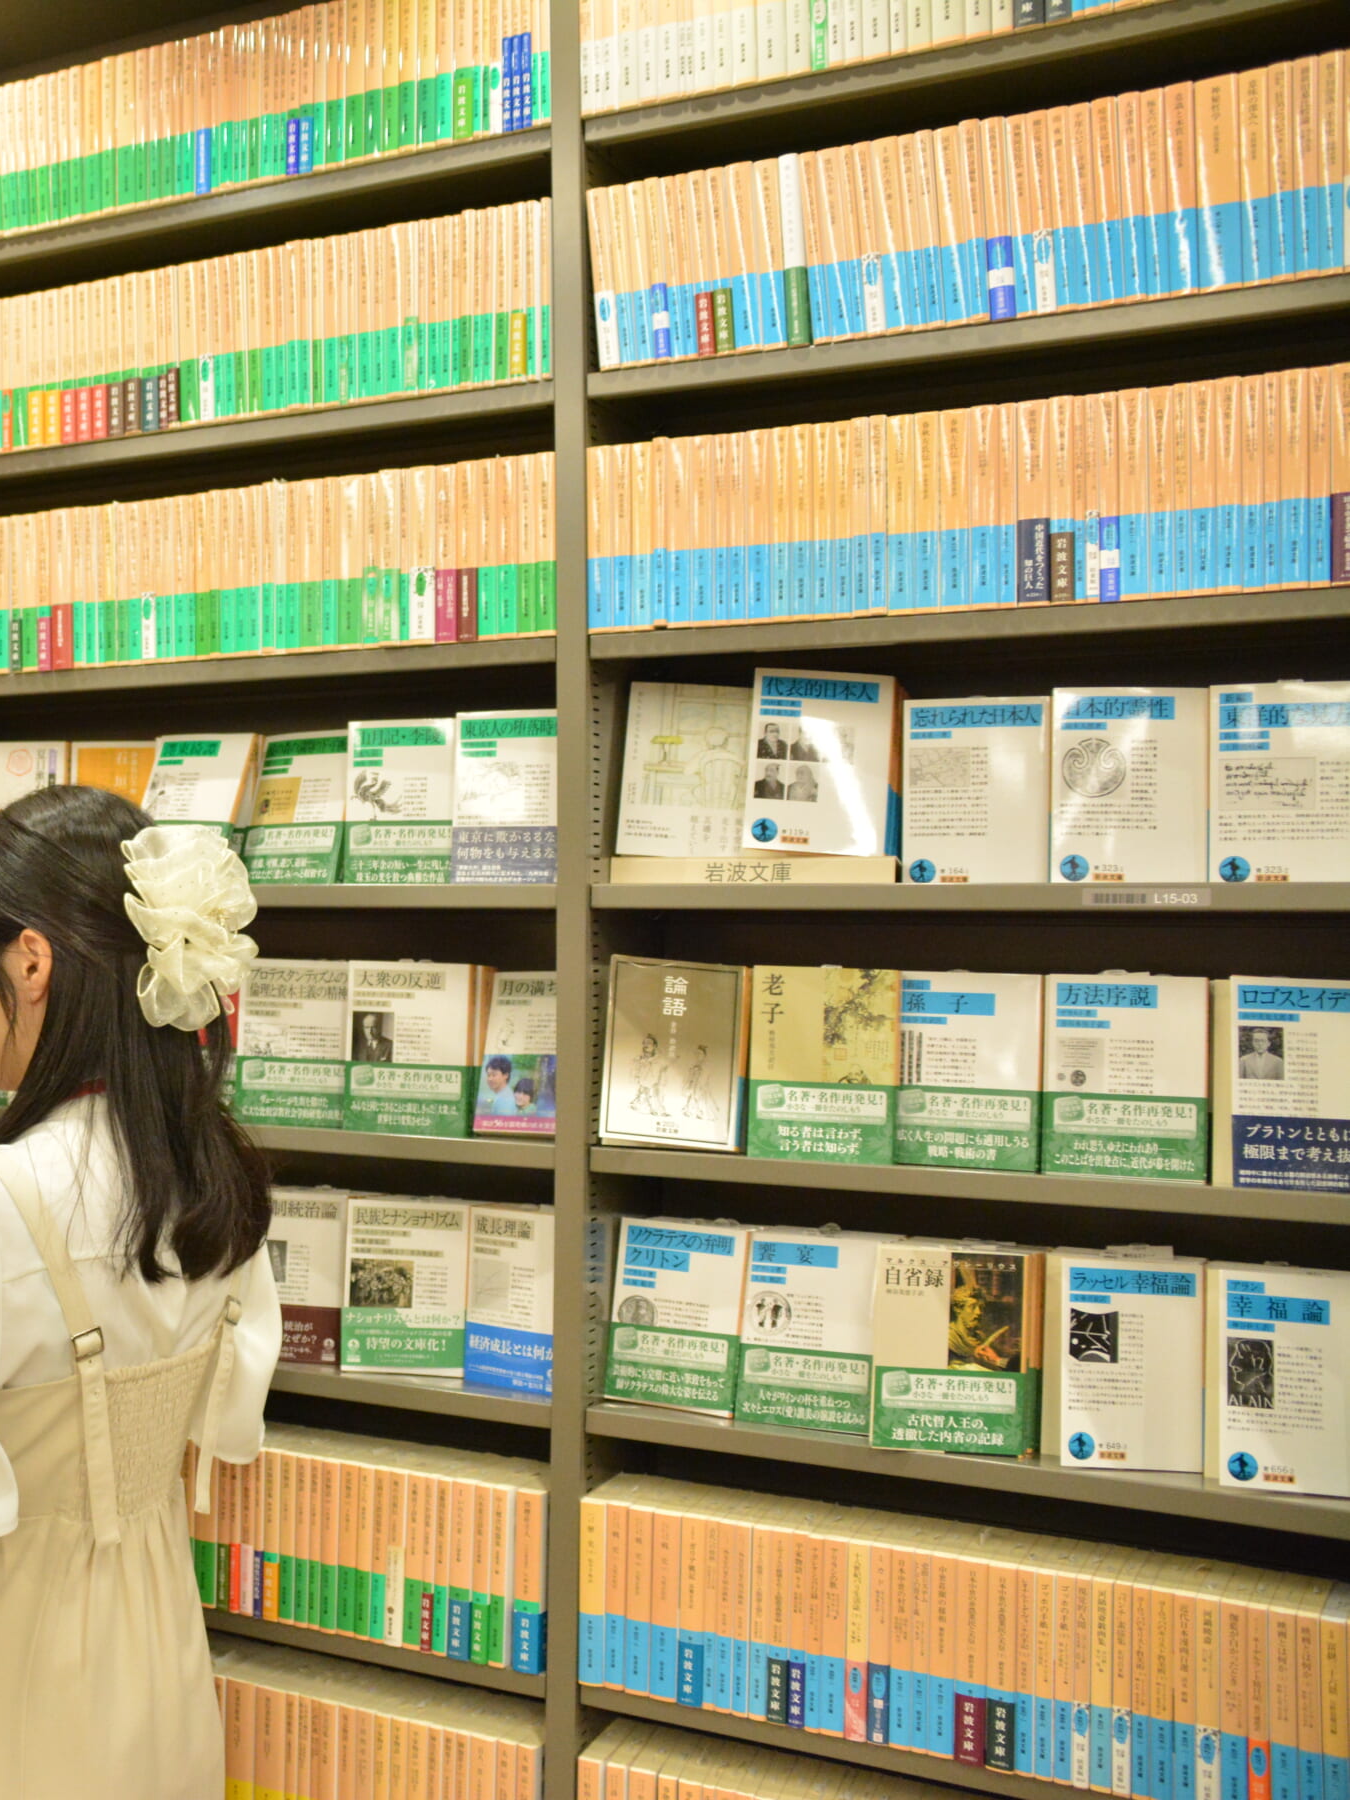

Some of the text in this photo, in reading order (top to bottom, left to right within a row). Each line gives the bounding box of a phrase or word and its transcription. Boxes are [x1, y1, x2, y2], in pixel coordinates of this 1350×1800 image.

[1056, 538, 1068, 588] 岩波文庫
[766, 677, 875, 701] 代表的日本人
[913, 706, 1039, 728] 忘れられた日本人
[1065, 698, 1169, 719] 日本的霊性
[704, 862, 792, 884] 岩波文庫
[1153, 893, 1199, 905] L15-03
[251, 968, 347, 985] プロテスタンティズムの
[360, 970, 442, 990] 大衆の反逆
[250, 983, 348, 1000] 倫理と資本主義の精神
[662, 975, 689, 1017] 論語
[761, 973, 786, 1025] 老子
[1061, 984, 1152, 1007] 方法序説
[377, 1070, 459, 1084] 名著・名作再発見!
[787, 1089, 884, 1107] 名著・名作再発見!
[928, 1095, 1028, 1113] 名著・名作再発見!
[1086, 1102, 1194, 1120] 名著・名作再発見!
[777, 1125, 864, 1141] 知る者は言わず、
[779, 1138, 862, 1155] 言う者は知らず。
[927, 1145, 997, 1161] 戦略・戦術の書
[355, 1208, 460, 1228] 民族とナショナリズム
[476, 1217, 532, 1239] 成長理論
[630, 1228, 733, 1255] ソクラテスの弁明
[627, 1249, 687, 1269] クリトン
[884, 1266, 945, 1289] 自省録
[1231, 1280, 1259, 1292] アラン
[366, 1337, 447, 1352] 待望の文庫化!
[640, 1333, 726, 1354] 名著・名作再発見!
[773, 1355, 866, 1376] 名著・名作再発見!
[913, 1376, 1013, 1394] 名著・名作再発見!
[890, 1427, 1005, 1446] 透徹した内省の記録
[452, 1604, 461, 1648] 岩波文庫
[474, 1609, 482, 1652] 岩波文庫
[520, 1618, 530, 1662] 岩波文庫
[683, 1648, 693, 1695] 岩波文庫
[770, 1663, 781, 1712] 岩波文庫
[790, 1667, 801, 1716] 岩波文庫
[963, 1702, 975, 1751] 岩波文庫
[995, 1706, 1007, 1757] 岩波文庫
